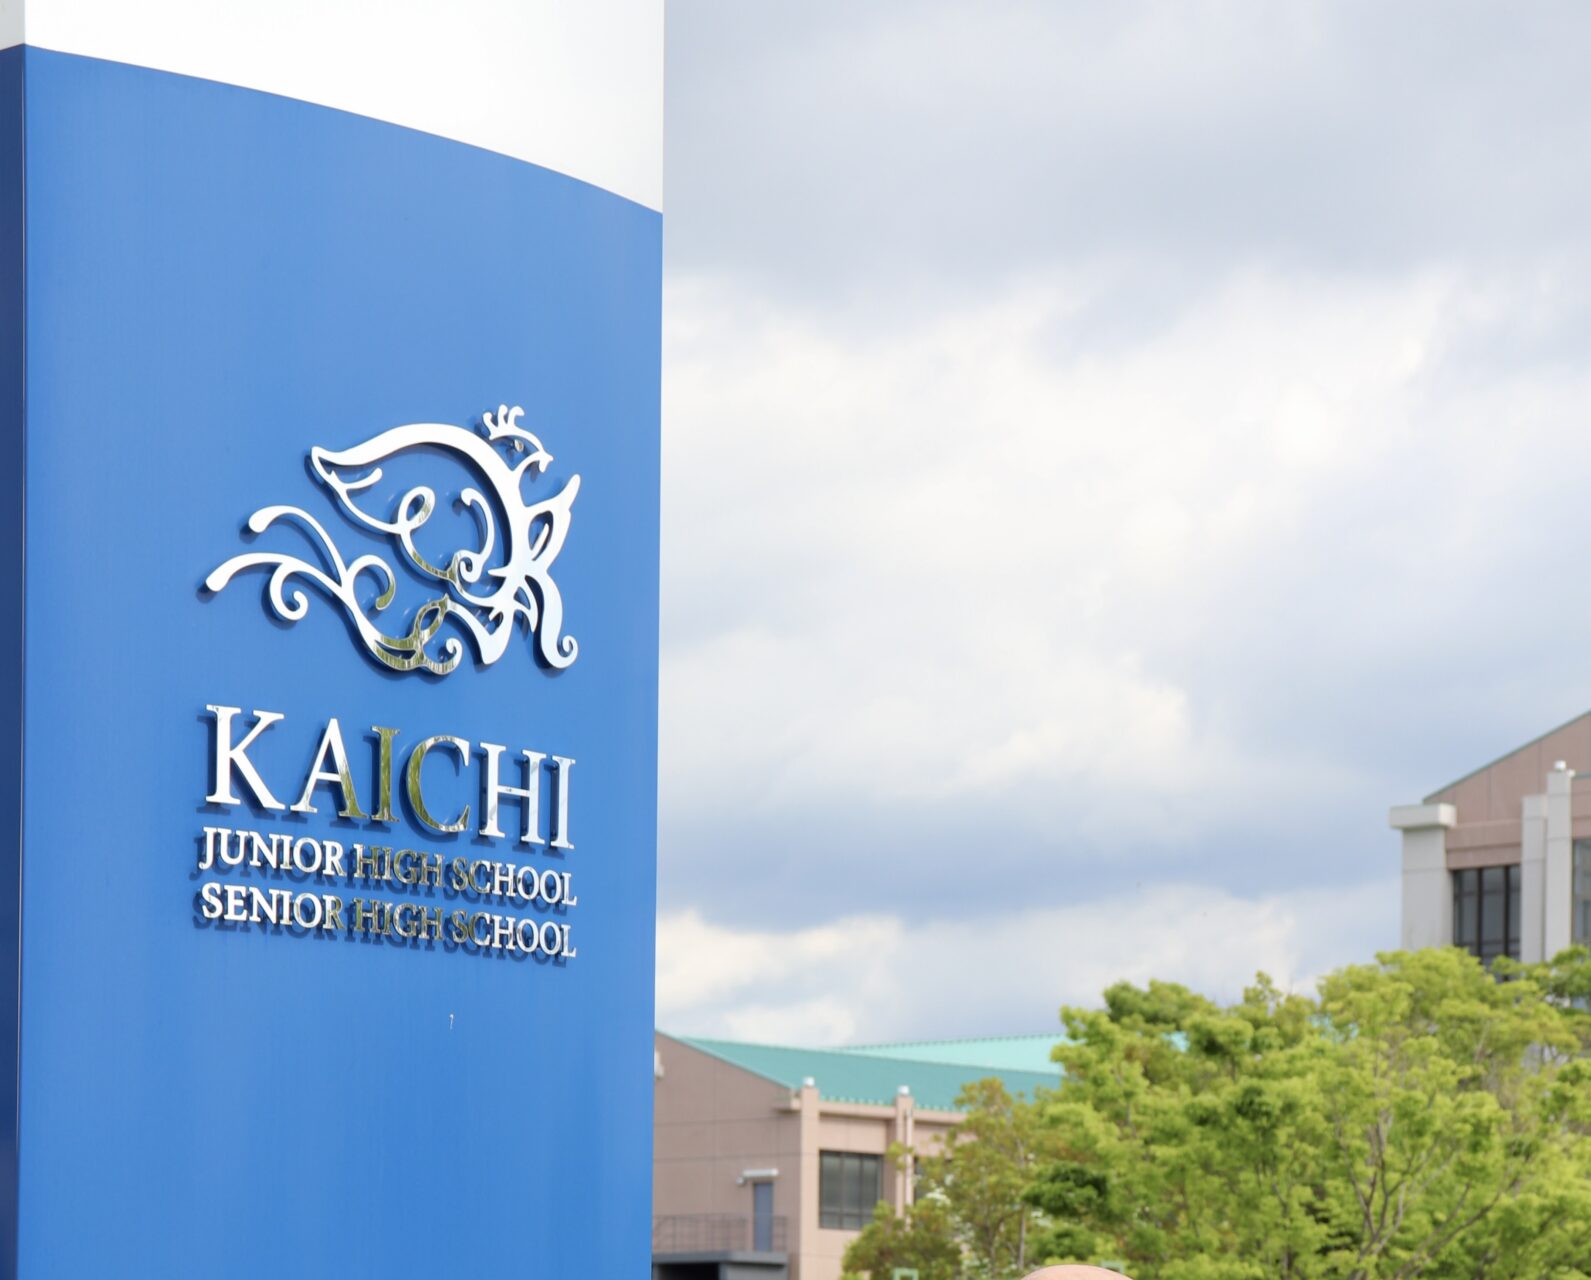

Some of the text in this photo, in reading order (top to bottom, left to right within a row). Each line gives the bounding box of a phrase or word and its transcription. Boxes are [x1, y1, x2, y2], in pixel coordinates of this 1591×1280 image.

[205, 704, 577, 849] KAICHI
[199, 826, 577, 906] JUNIOR HIGH SCHOOL
[201, 882, 577, 957] SENIOR HIGH SCHOOL
